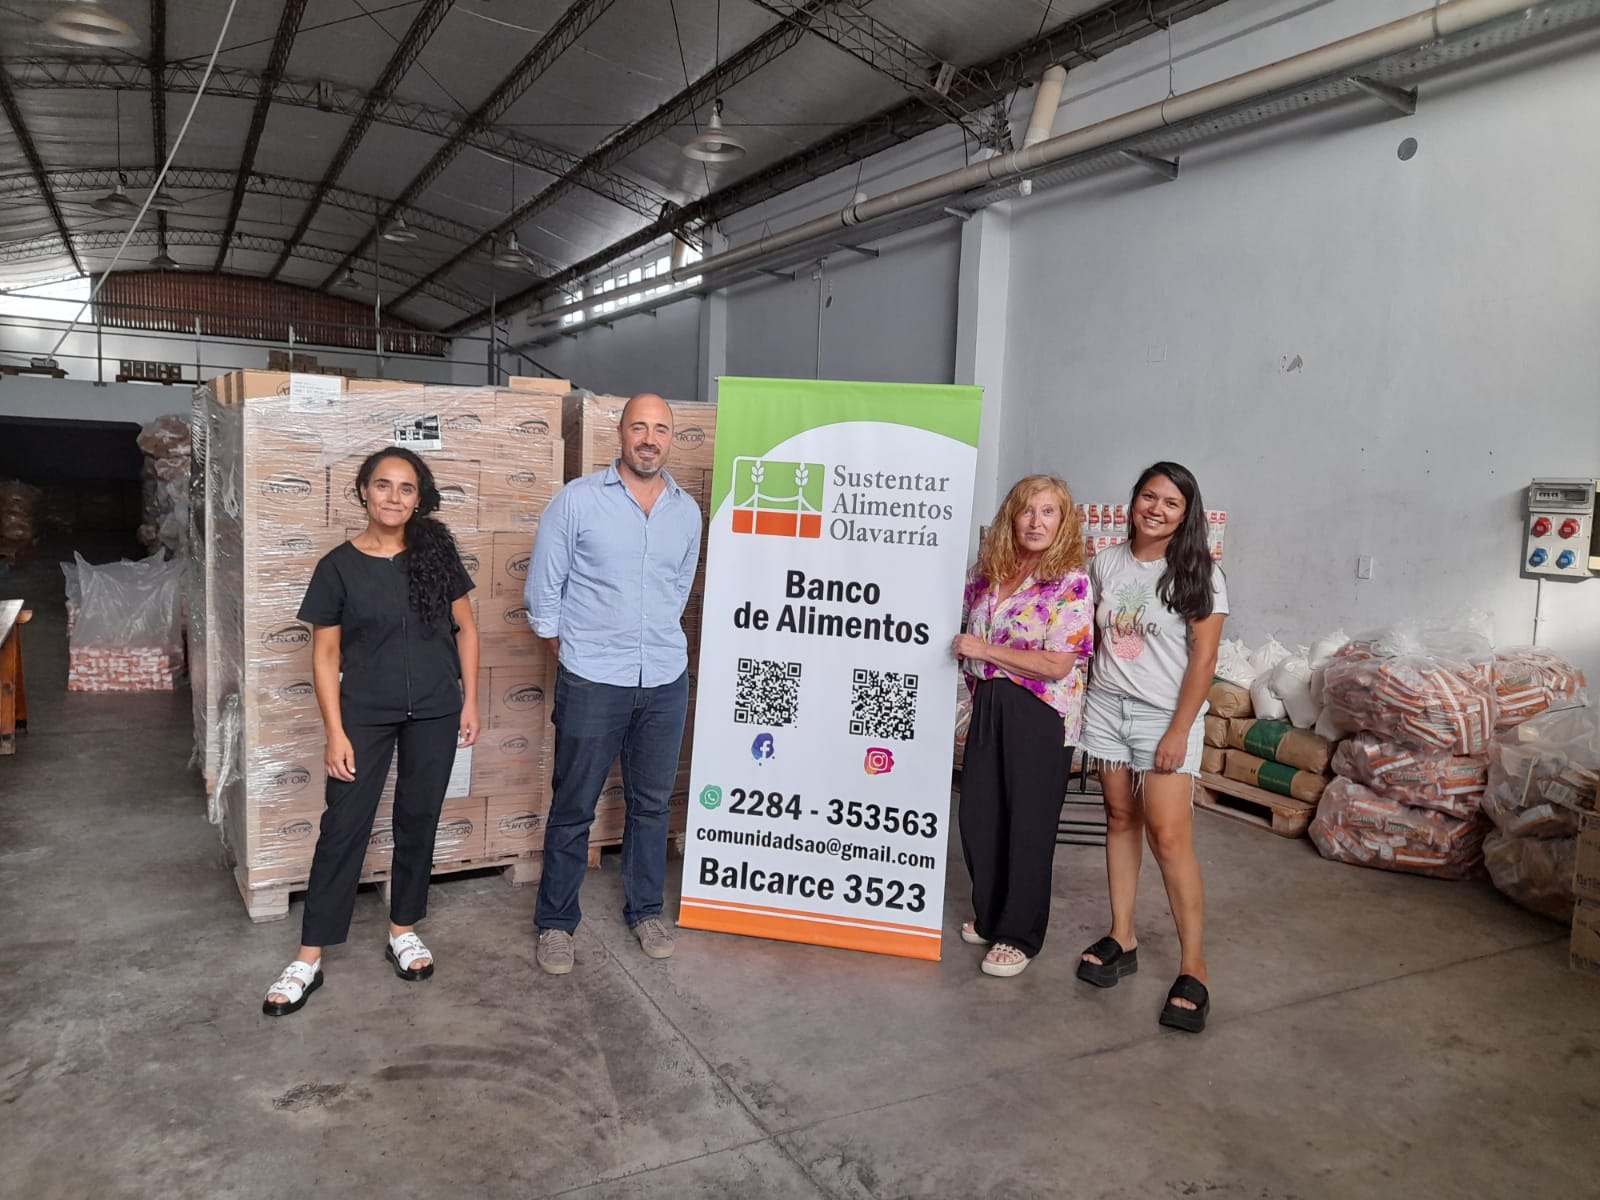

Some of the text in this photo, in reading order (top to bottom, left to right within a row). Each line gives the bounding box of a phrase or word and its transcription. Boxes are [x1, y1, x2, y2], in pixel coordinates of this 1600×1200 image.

[833, 464, 951, 493] Sustentar
[831, 493, 953, 521] Alimentos
[829, 518, 939, 547] Olavarría
[509, 561, 530, 571] ARC
[785, 569, 881, 605] Banco
[263, 633, 309, 643] ARCOR
[733, 601, 930, 645] de Alimentos
[1103, 604, 1162, 645] Aloha
[506, 693, 544, 703] ARCOR
[728, 788, 802, 820] 2284
[826, 798, 938, 839] 353563
[696, 826, 936, 870] comunidadsao@gmail.com
[699, 857, 927, 913] Balcarce 3523
